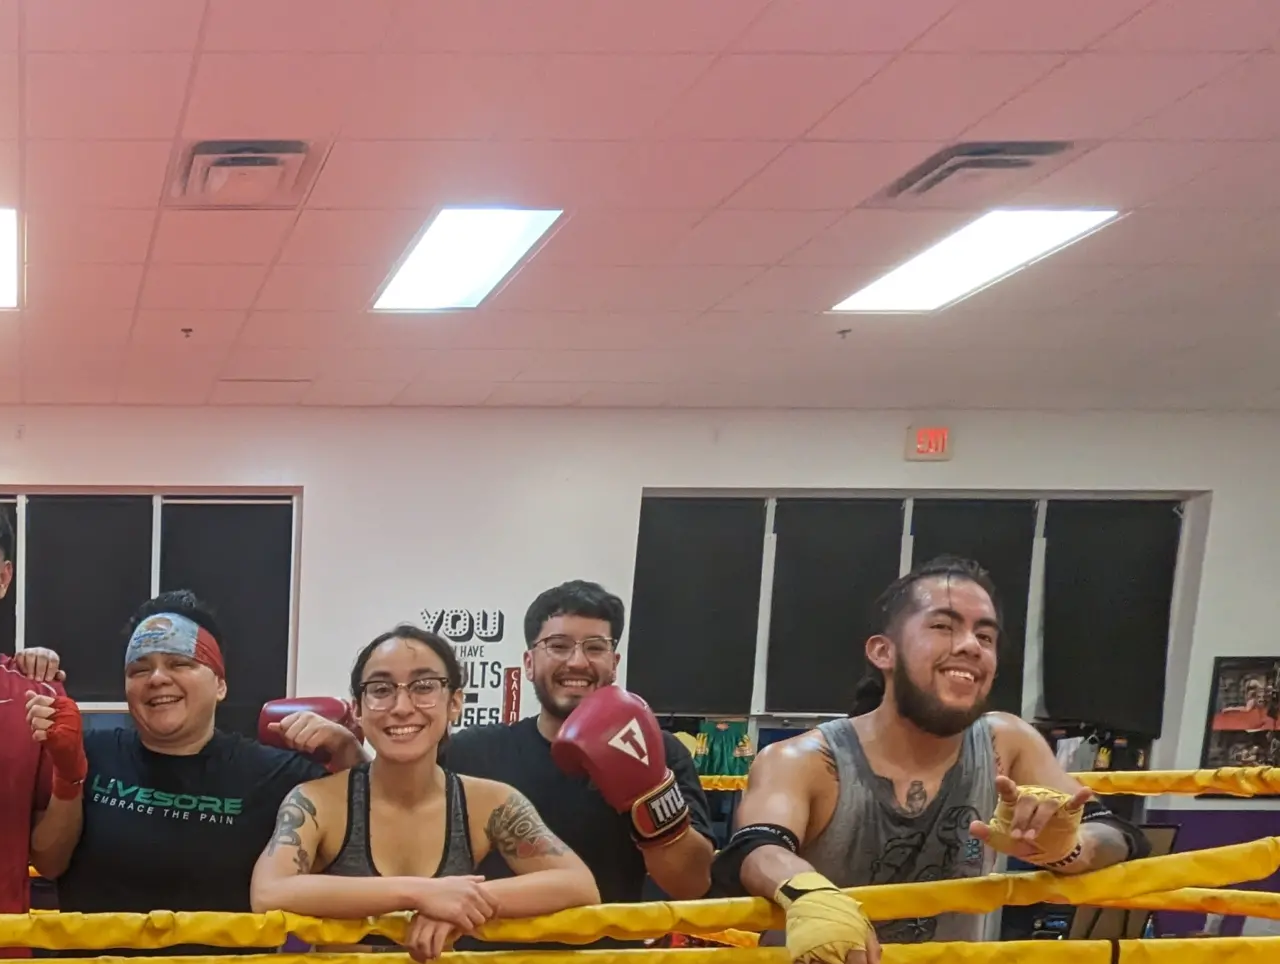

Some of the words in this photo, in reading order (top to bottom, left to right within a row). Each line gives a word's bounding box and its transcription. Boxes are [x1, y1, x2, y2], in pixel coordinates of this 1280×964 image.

[917, 428, 949, 453] EXIT
[421, 608, 505, 642] YOU
[460, 645, 485, 658] HAVE
[91, 773, 244, 815] LIVESORE
[93, 793, 155, 815] EMBRACE
[163, 808, 190, 820] THE
[200, 813, 234, 825] PAIN
[650, 781, 685, 823] TITL
